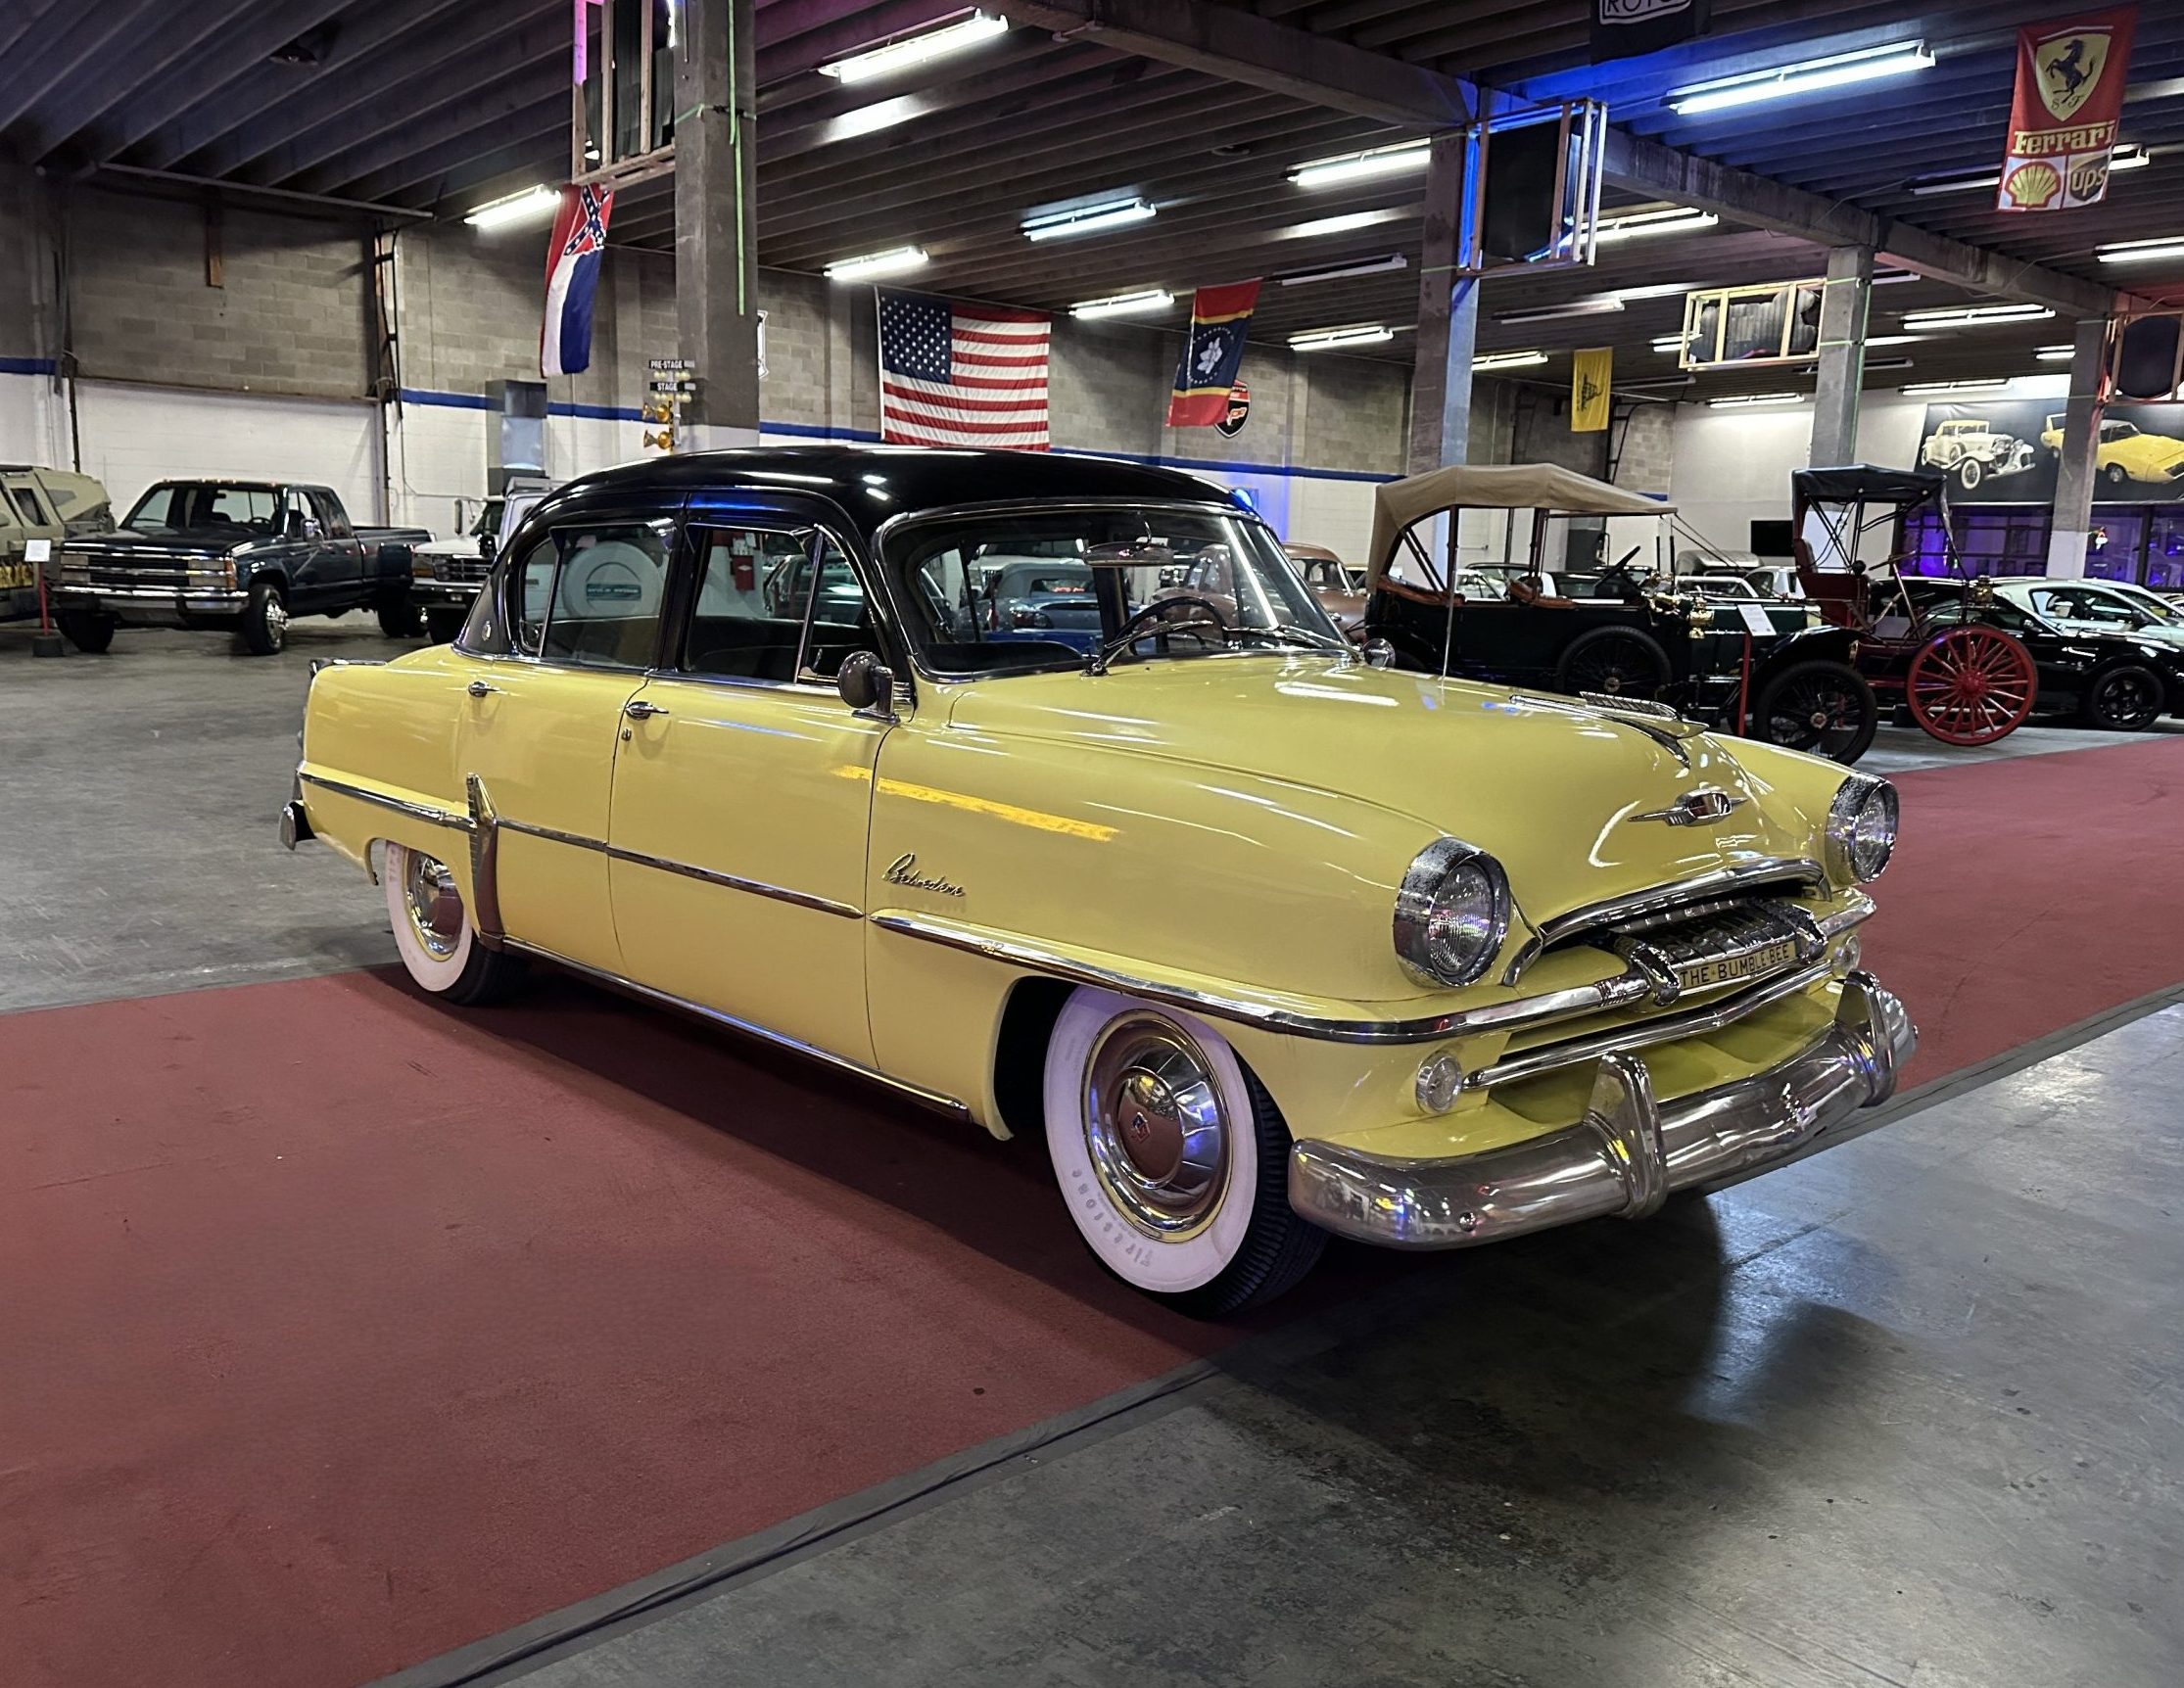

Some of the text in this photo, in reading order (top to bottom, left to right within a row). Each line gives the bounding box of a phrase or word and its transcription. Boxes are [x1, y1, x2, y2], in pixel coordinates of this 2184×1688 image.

[2012, 120, 2115, 154] Ferrari
[2071, 166, 2107, 197] ups
[650, 359, 684, 369] PRE-STAGE
[657, 382, 678, 392] STAGE
[1680, 943, 1790, 988] THE BUMBLE BEE
